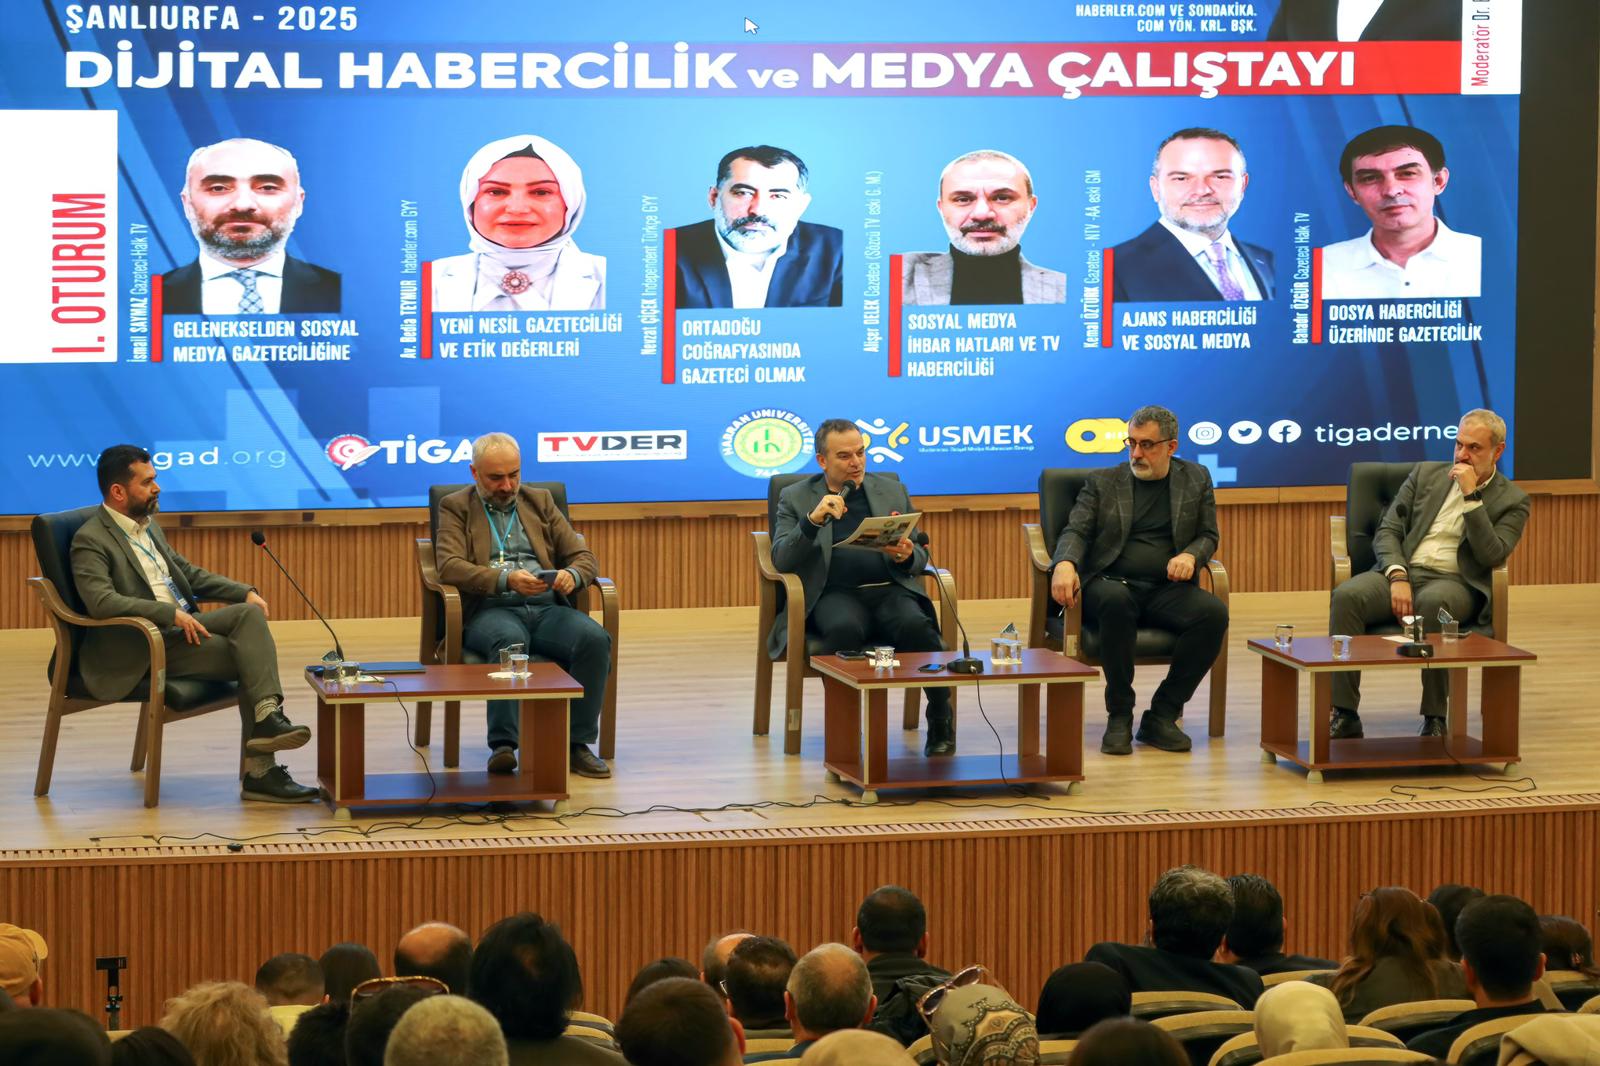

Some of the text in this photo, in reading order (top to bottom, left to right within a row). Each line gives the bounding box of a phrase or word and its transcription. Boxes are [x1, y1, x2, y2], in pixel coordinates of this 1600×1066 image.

[66, 5, 239, 33] ŞANLIURFA
[278, 5, 358, 31] 2025
[1075, 2, 1257, 17] HABERLER.COM VE SONDAKİKA.
[1471, 7, 1490, 21] Dr.
[1136, 17, 1257, 34] COM YÖN. KRL. BŞK.
[1471, 24, 1490, 86] Moderatör
[65, 40, 1354, 100] DİJİTAL HABERCİLİK ve MEDYA ÇALIŞTAYI
[1085, 170, 1100, 184] GM
[641, 195, 659, 213] GYY
[1085, 186, 1100, 203] eski
[865, 199, 880, 215] eski
[130, 223, 148, 234] TV
[641, 216, 661, 243] Türkçe
[865, 218, 881, 229] TV
[1085, 224, 1099, 240] NTV
[51, 193, 106, 353] I. OTURUM
[1084, 251, 1099, 283] Gazeteci
[400, 199, 418, 359] Av. Bedia TEYMUR haberler.com GYY
[864, 262, 880, 296] Gazeteci
[1290, 212, 1310, 344] Bahadır ÖZGÜR Gazeteci Halk TV
[638, 298, 661, 323] ÇİÇEK
[863, 299, 880, 325] DELEK
[1080, 286, 1099, 319] ÖZTÜRK
[1328, 300, 1463, 321] DOSYA HABERCİLİĞİ
[129, 297, 148, 333] SAYMAZ
[439, 312, 623, 334] YENİ NESİL GAZETECİLİĞİ
[908, 312, 1017, 330] SOSYAL MEDYA
[1122, 306, 1257, 327] AJANS HABERCİLİĞİ
[173, 320, 359, 338] GELENEKSELDEN SOSYAL
[682, 316, 761, 336] ORTADOĞU
[1083, 323, 1098, 348] Kemal
[1328, 323, 1483, 344] ÜZERİNDE GAZETECİLİK
[439, 338, 580, 358] VE ETİK DEĞERLERİ
[640, 326, 657, 355] Nevzat
[682, 341, 801, 360] COĞRAFYASINDA
[863, 328, 883, 353] Alişer
[907, 335, 1060, 353] İHBAR HATLARI VE TV
[1122, 332, 1251, 350] VE SOSYAL MEDYA
[173, 341, 351, 362] MEDYA GAZETECİLİĞİNE
[682, 364, 806, 384] GAZETECİ OLMAK
[907, 357, 995, 377] HABERCİLİĞİ
[543, 435, 682, 452] TVDER
[721, 414, 752, 456] HARRAN
[919, 424, 1033, 446] USMEK
[1315, 422, 1459, 447] tigaderne
[379, 434, 473, 464] TİGA
